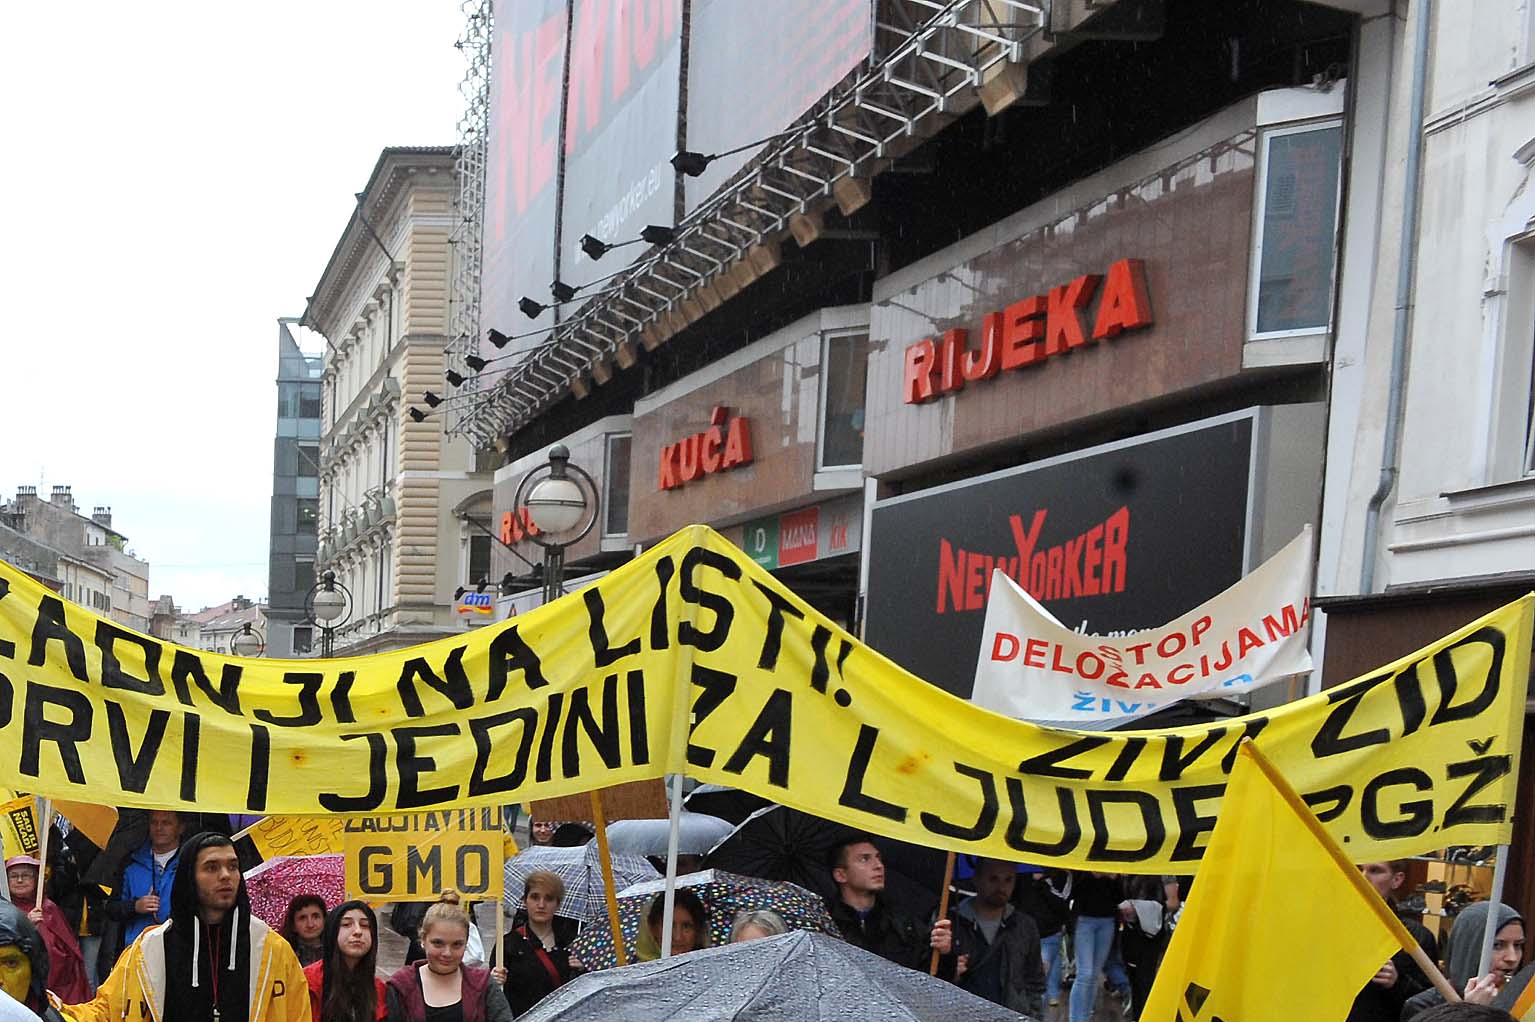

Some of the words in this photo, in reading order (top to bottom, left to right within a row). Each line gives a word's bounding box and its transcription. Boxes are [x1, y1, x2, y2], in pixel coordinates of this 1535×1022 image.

[904, 258, 1152, 404] RIJEKA
[658, 406, 752, 491] KUĆA
[397, 625, 550, 717] NA
[583, 546, 854, 708] LISTI!
[1311, 625, 1507, 760] ZID
[246, 723, 270, 812] I
[318, 669, 650, 813] JEDINI
[687, 662, 793, 790] ZA
[358, 844, 490, 896] GMO
